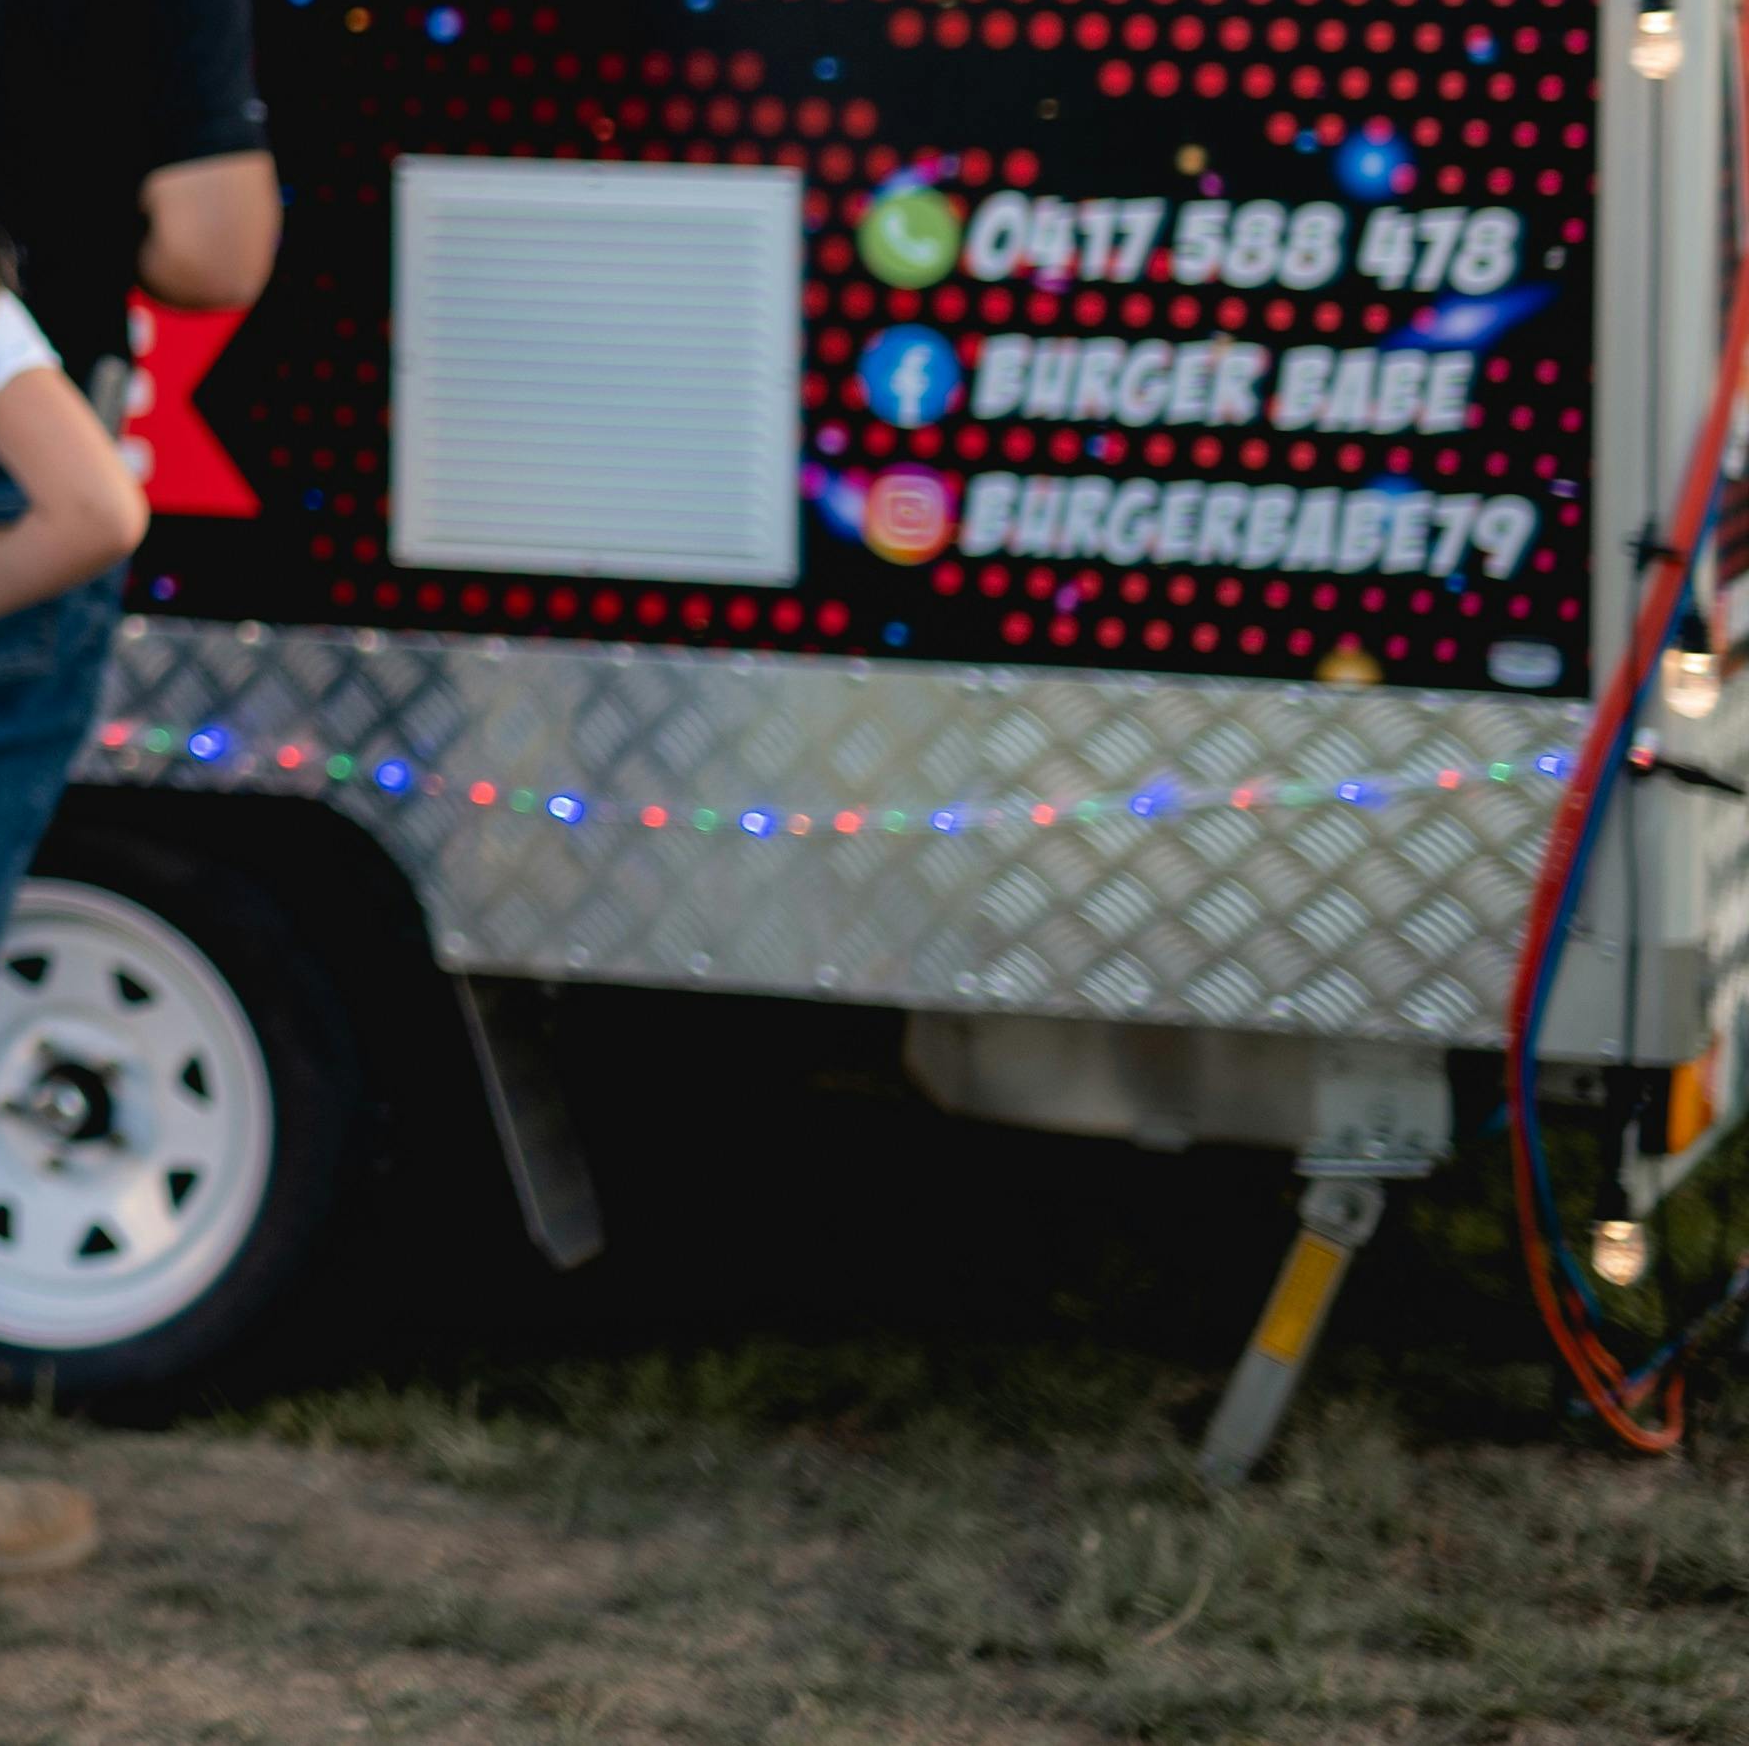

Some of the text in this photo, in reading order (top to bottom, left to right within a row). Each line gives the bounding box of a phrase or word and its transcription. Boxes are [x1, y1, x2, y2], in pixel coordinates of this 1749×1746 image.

[964, 190, 1523, 296] 0417 588 478
[971, 332, 1270, 427] BURGER
[1273, 343, 1475, 434] BABE
[959, 470, 1538, 581] BURGERBABE79
